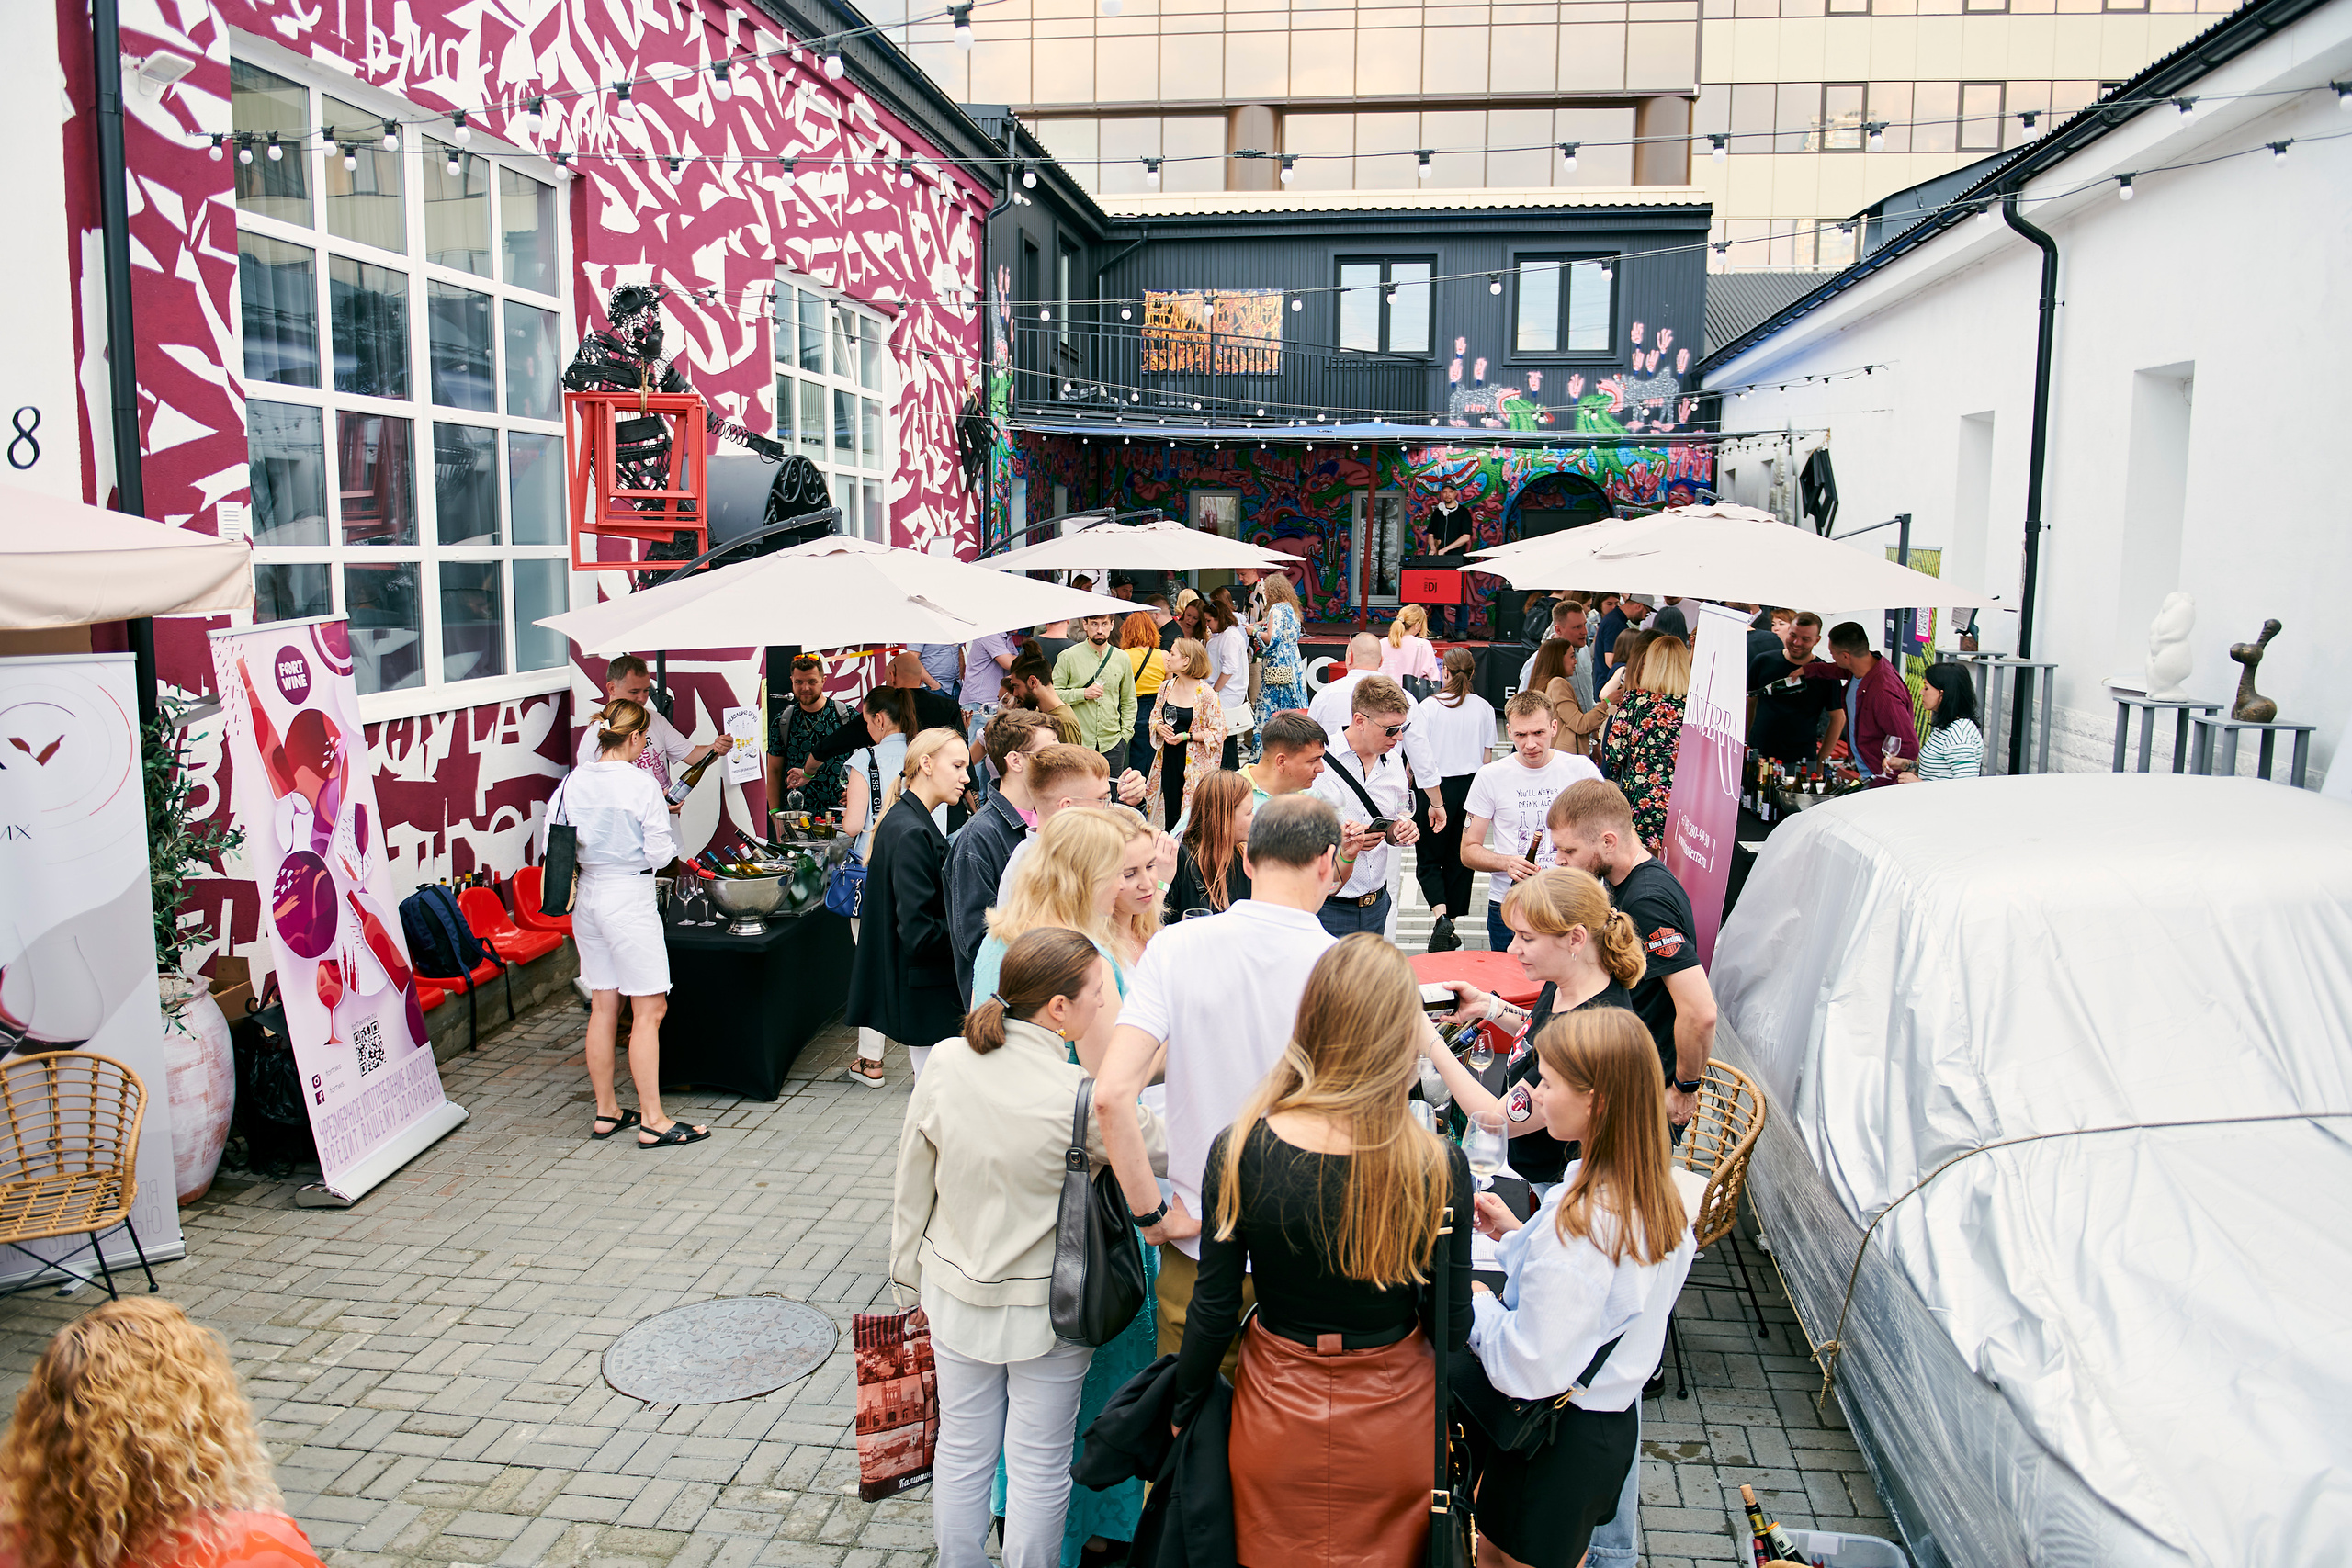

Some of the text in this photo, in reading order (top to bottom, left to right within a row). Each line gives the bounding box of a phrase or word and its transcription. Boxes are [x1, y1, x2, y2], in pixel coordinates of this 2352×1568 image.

[7, 406, 41, 470] 8
[277, 660, 304, 677] FORT
[281, 673, 308, 691] WINE
[317, 1096, 364, 1145] ЧРЕЗМЕРНОЕ
[359, 1067, 408, 1118] УПОТРЕБЛЕНИЕ
[323, 1072, 441, 1172] ВРЕДИТ ВАШЕМУ ЗДОРОВЬЮ
